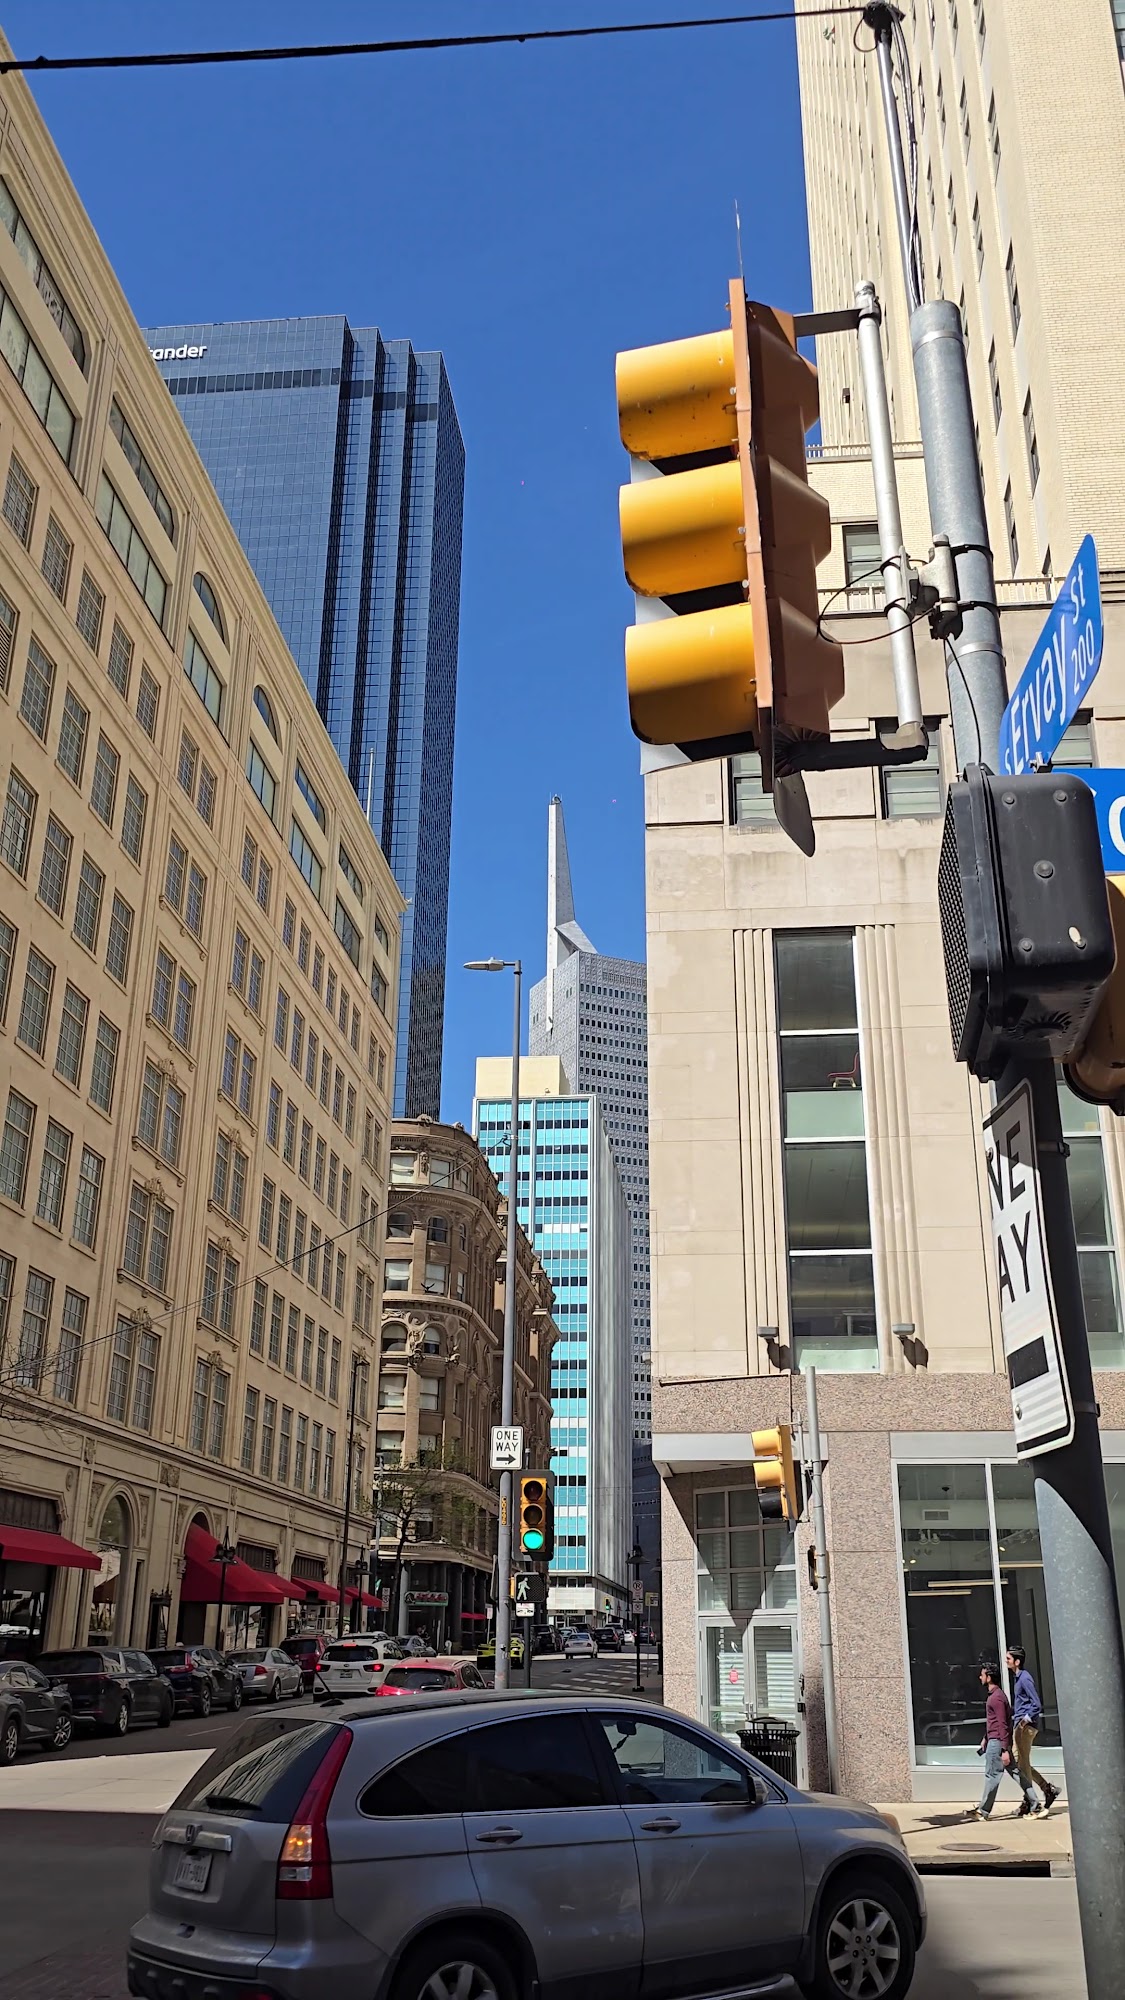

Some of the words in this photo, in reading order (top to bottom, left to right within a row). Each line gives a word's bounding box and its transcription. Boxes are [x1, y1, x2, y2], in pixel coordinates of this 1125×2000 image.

[1010, 613, 1067, 776] Ervay
[1070, 562, 1086, 625] St
[1071, 618, 1095, 695] 200
[986, 1120, 1026, 1212] NE
[997, 1210, 1031, 1305] AY
[495, 1441, 519, 1452] WAY
[496, 1430, 519, 1441] ONE
